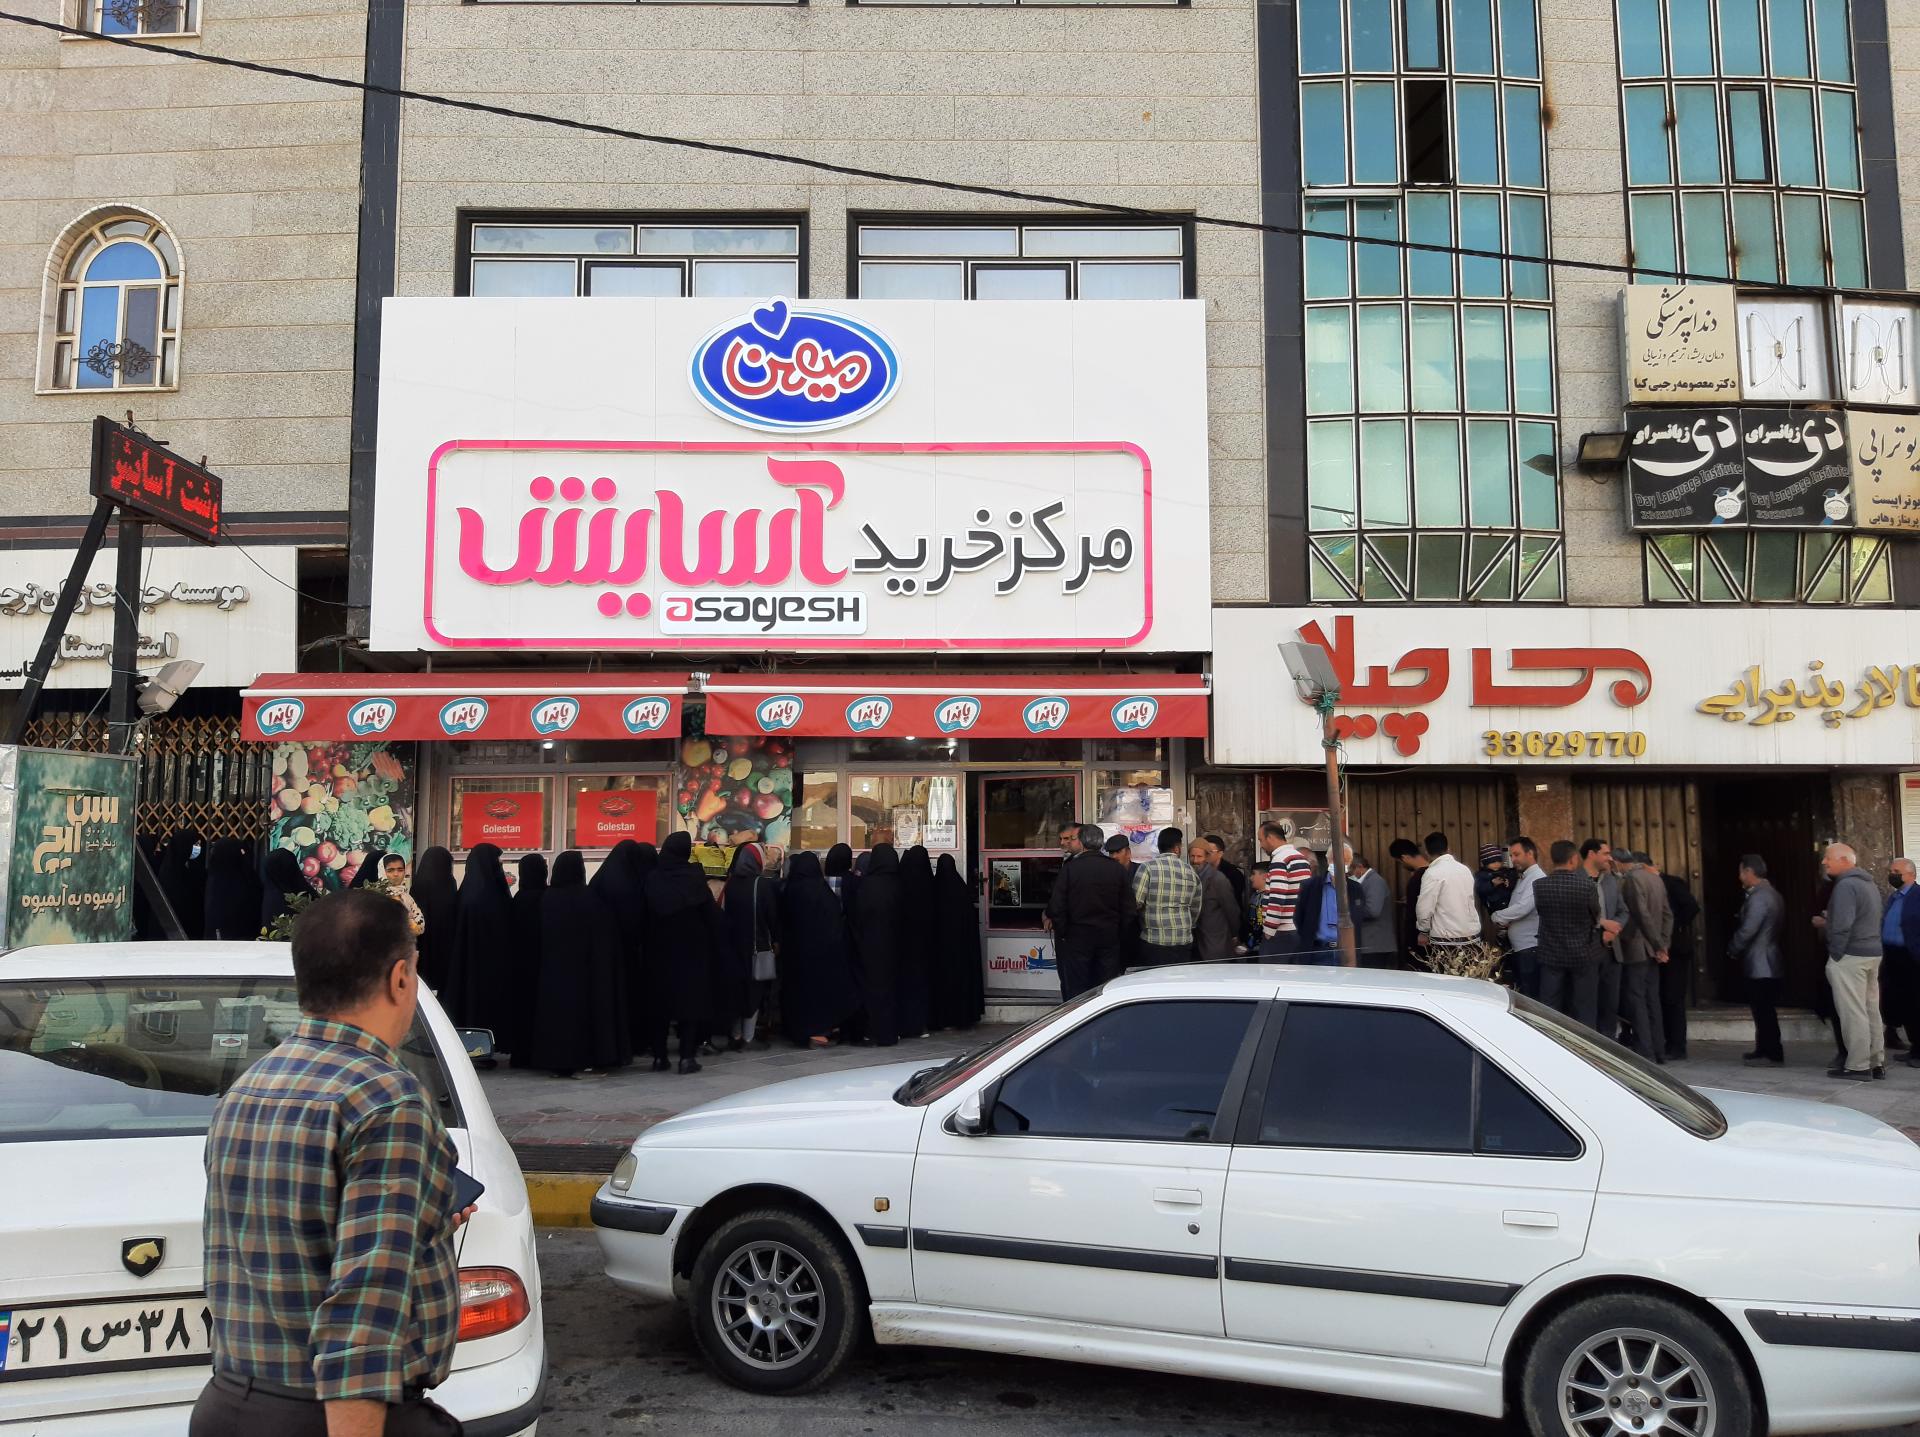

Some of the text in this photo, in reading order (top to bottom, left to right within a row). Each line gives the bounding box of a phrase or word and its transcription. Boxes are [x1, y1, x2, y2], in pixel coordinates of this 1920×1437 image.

[723, 337, 871, 403] میهن
[1676, 379, 1714, 392] معصومه
[1713, 378, 1737, 392] دکتر
[1744, 423, 1801, 444] زبانسرای
[1858, 426, 1920, 484] یوتراپی
[1634, 493, 1657, 509] Day
[1655, 475, 1701, 505] Language
[1769, 476, 1812, 504] Language
[455, 455, 1133, 619] مرکز خرید آسایش
[1482, 730, 1647, 758] 33629770
[482, 824, 521, 834] Golestan
[597, 821, 635, 832] Golestan
[21, 883, 68, 914] آبمیوه
[84, 891, 116, 911] میوه
